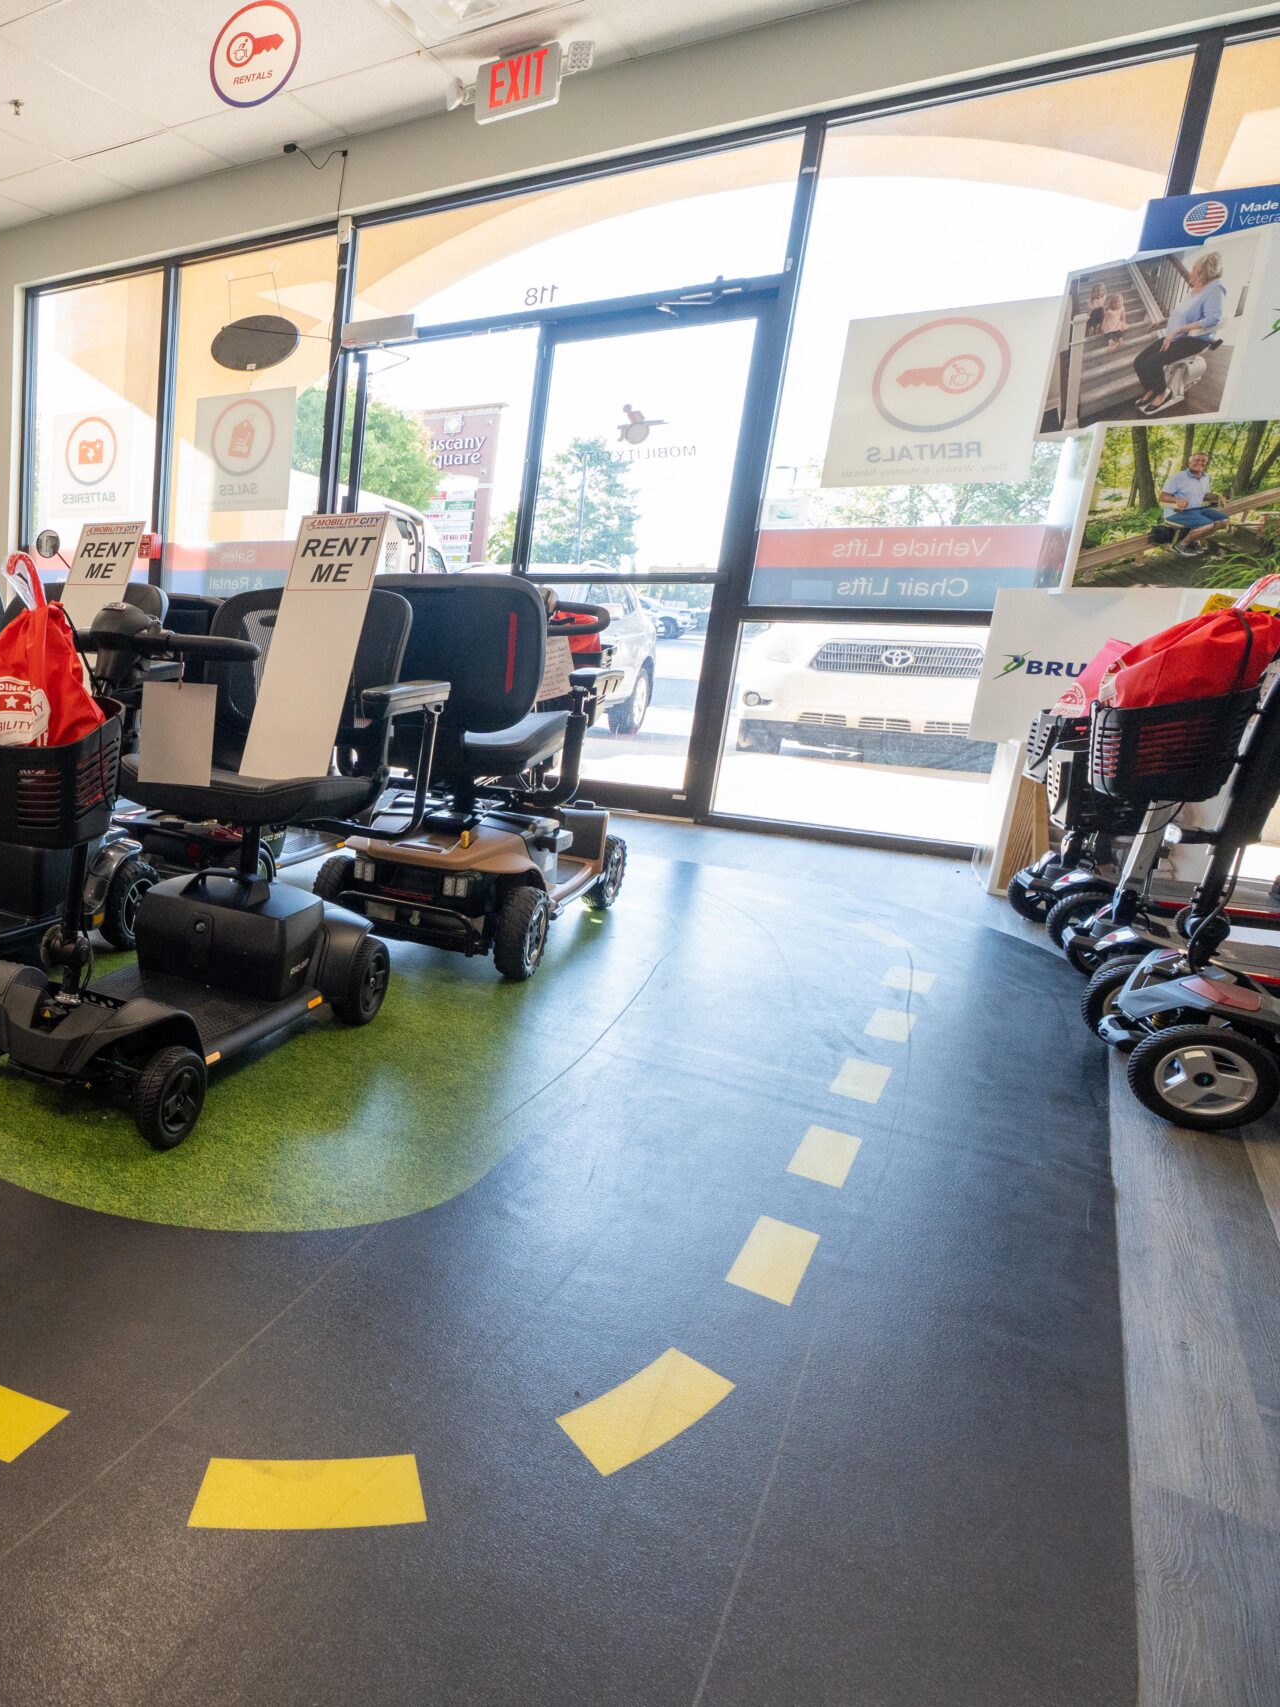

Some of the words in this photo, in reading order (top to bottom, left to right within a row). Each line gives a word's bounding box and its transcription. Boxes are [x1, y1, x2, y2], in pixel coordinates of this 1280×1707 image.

[233, 69, 273, 86] RENTALS
[489, 48, 548, 109] EXIT
[1240, 200, 1278, 213] Made
[431, 436, 487, 451] uscany
[433, 452, 481, 469] quare
[317, 518, 359, 526] MOBILITY
[80, 541, 136, 558] RENT
[301, 537, 377, 557] RENT
[85, 563, 117, 579] ME
[310, 563, 353, 582] ME
[1026, 660, 1087, 677] BRU
